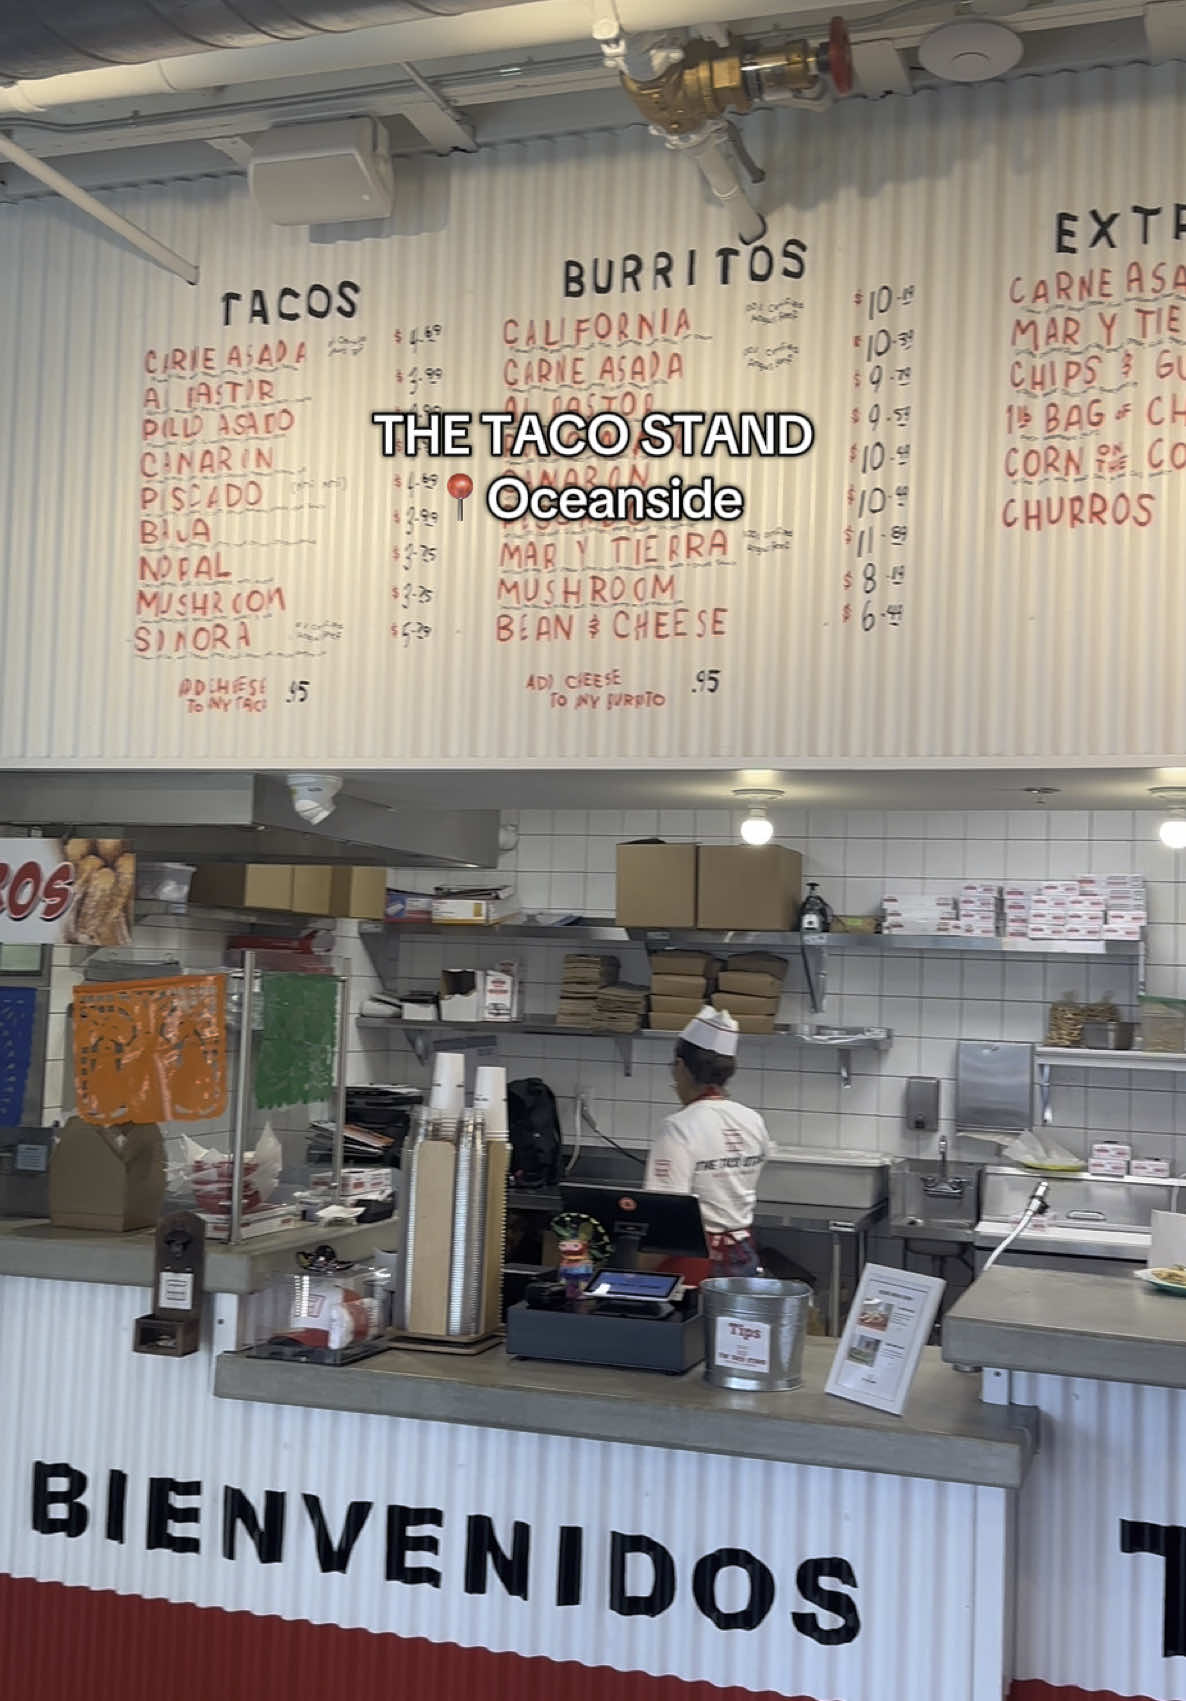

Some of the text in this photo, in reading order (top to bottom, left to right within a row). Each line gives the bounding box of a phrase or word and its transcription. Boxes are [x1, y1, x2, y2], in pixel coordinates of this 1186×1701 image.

[563, 238, 808, 298] BURRITOS
[1009, 268, 1112, 303] CARNE
[221, 280, 360, 326] TACOS
[503, 307, 691, 346] CALIFORNIA
[1010, 305, 1181, 350] MAR Y TIE
[503, 351, 685, 387] CARNE ASADA
[1010, 355, 1102, 390] CHIPS
[1045, 399, 1106, 433] BAG
[1004, 445, 1083, 477] CORN
[1002, 492, 1155, 531] CHURROS
[138, 552, 232, 581] NOPAL
[500, 541, 557, 569] MAR
[576, 536, 588, 567] Y
[611, 529, 729, 565] TIERRA
[136, 587, 286, 617] MUSHROOM
[496, 574, 676, 606] MUSHROOM
[496, 613, 574, 642] BEAN
[612, 608, 729, 640] CHEESE
[691, 669, 721, 693] .95
[30, 1459, 862, 1647] BIENVENIDOS
